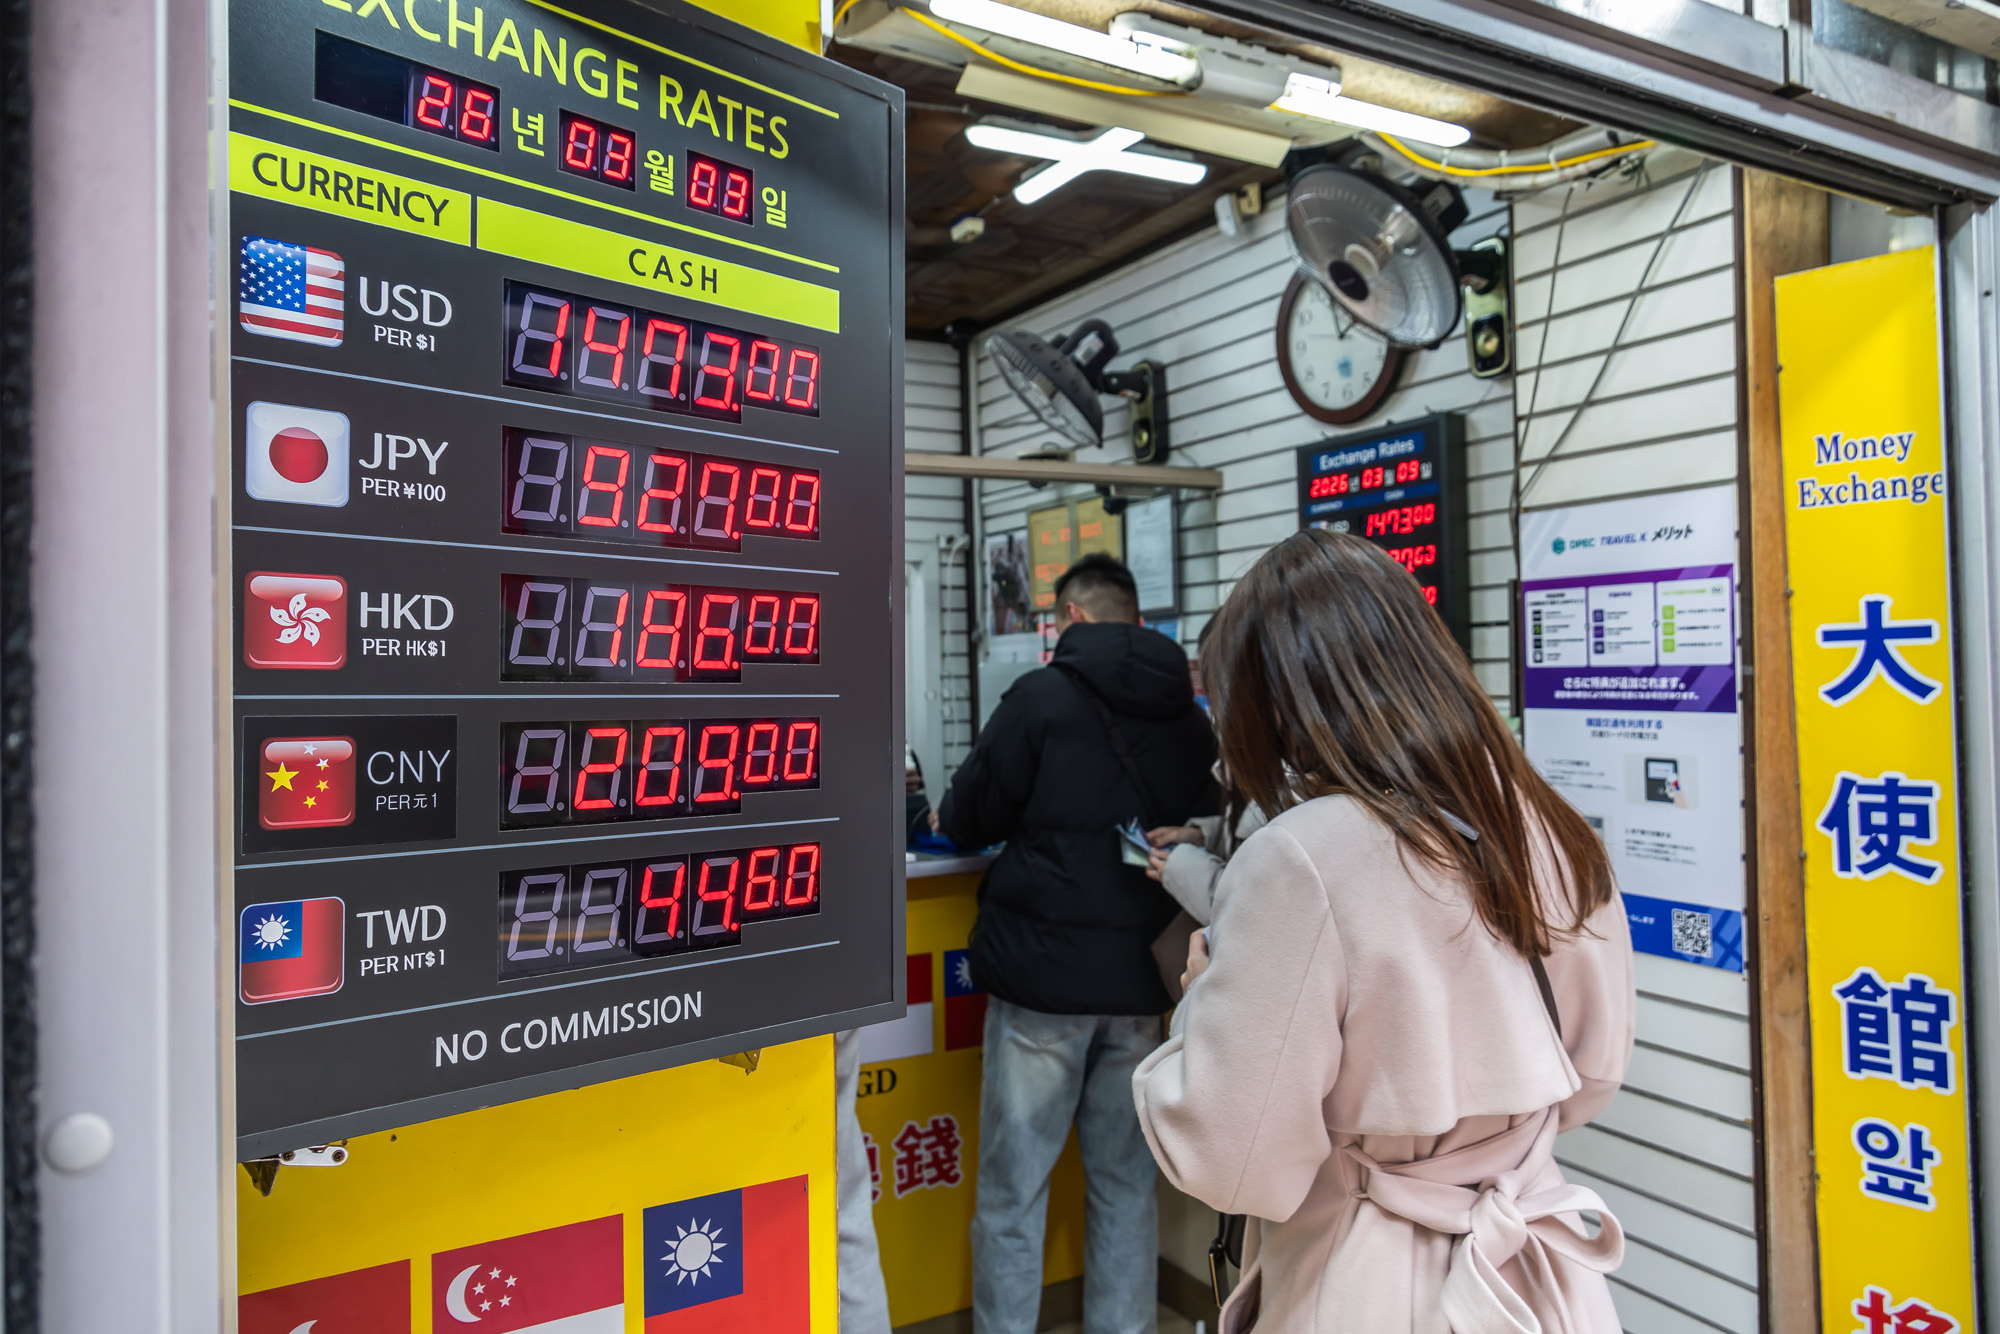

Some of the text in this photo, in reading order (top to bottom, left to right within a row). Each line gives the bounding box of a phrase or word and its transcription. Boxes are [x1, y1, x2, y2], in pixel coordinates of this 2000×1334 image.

[320, 0, 790, 160] CHANGE RATES
[416, 74, 788, 229] 26 년 03 월 03 일
[251, 152, 450, 227] CURRENCY
[628, 248, 718, 294] CASH
[359, 275, 453, 327] USD
[373, 324, 436, 352] PER $1
[358, 432, 449, 475] JPY
[1319, 439, 1415, 471] Exchange Rates
[1814, 431, 1915, 466] Money
[361, 476, 447, 502] PER ¥100
[1310, 473, 1349, 497] 2026
[1361, 467, 1384, 489] 03
[1396, 460, 1420, 482] 09
[1797, 471, 1943, 509] Exchange
[1652, 524, 1693, 542] メリット
[359, 591, 455, 631] HKD
[361, 638, 447, 657] PER HK$1
[366, 749, 451, 785] CNY
[356, 904, 447, 949] TWD
[359, 949, 446, 977] PER NT$1
[434, 990, 702, 1067] NO COMMISSION
[857, 1067, 897, 1098] GD
